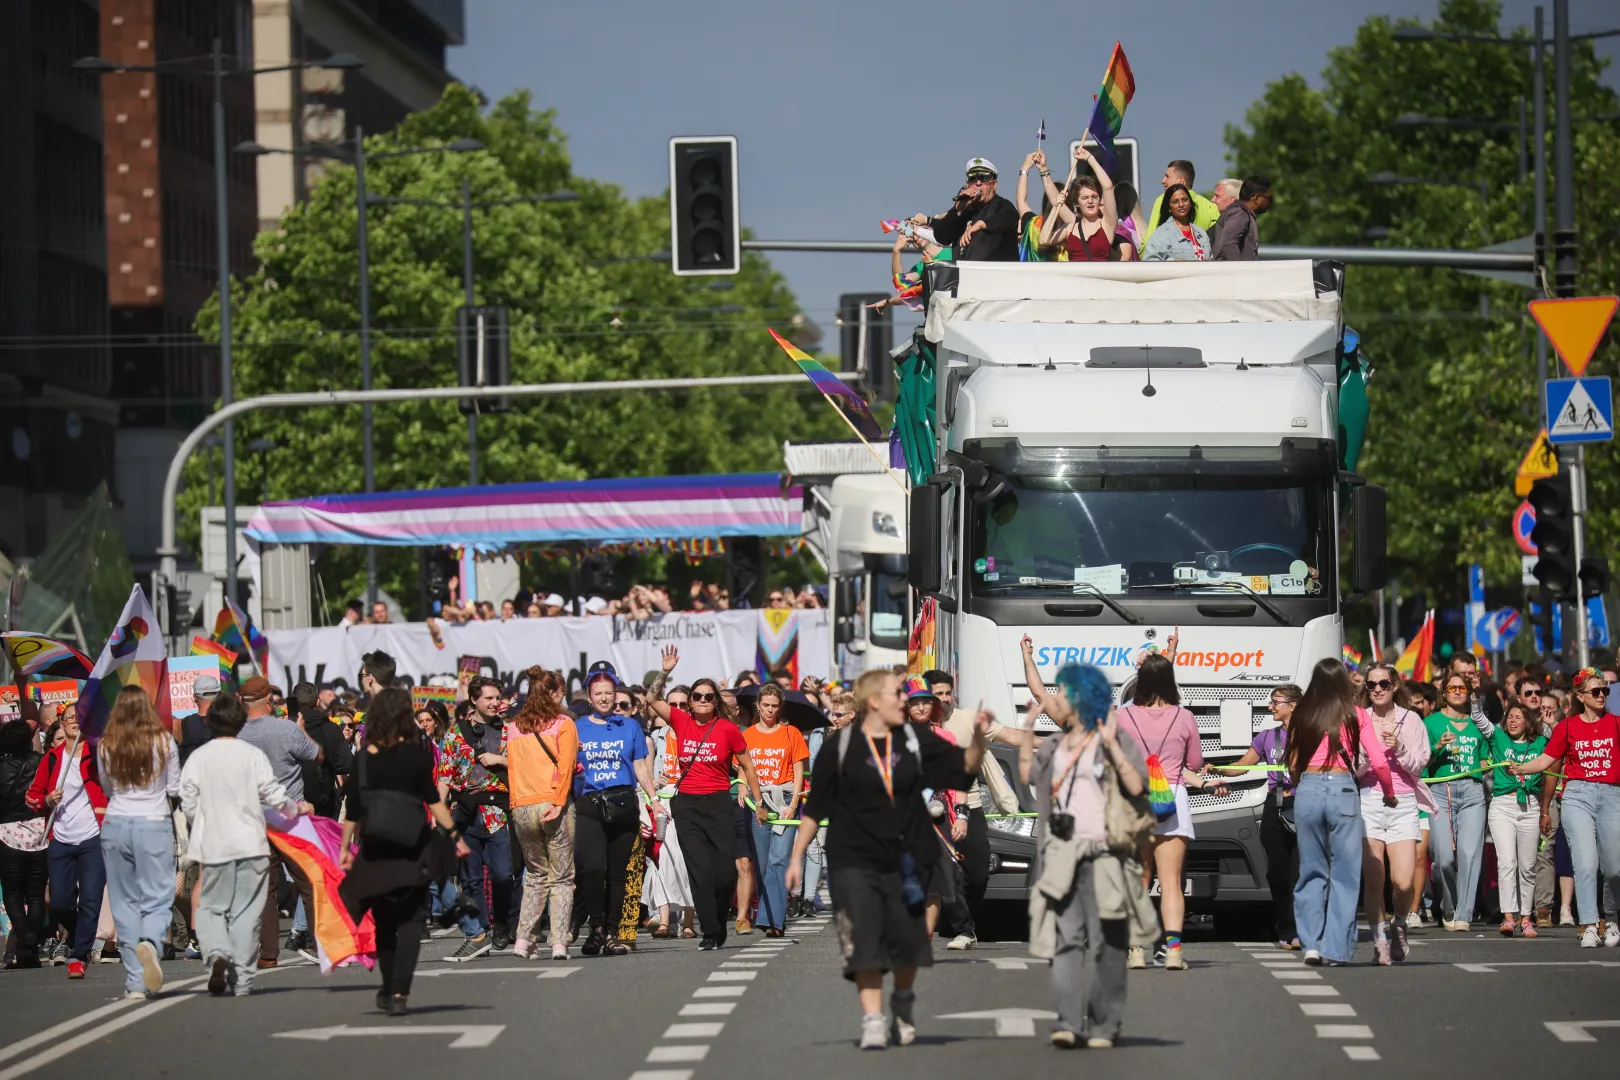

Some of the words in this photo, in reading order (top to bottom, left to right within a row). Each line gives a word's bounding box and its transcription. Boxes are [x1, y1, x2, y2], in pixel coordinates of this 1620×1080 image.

[1037, 646, 1133, 666] STRUZIK
[1160, 649, 1264, 672] tansport
[1229, 672, 1291, 681] ACTROS
[43, 690, 74, 700] WANT
[582, 741, 598, 751] LIFE
[602, 740, 624, 749] ISN'T
[683, 739, 696, 747] LIFE
[1575, 740, 1590, 750] LIFE
[1592, 737, 1613, 747] ISN'T
[586, 750, 622, 760] BINARY,
[764, 748, 785, 758] ISN'T
[1578, 748, 1612, 760] BINARY,
[752, 758, 782, 770] BINARY,
[1467, 755, 1474, 764] IS
[1580, 760, 1600, 769] NOR
[1602, 760, 1611, 769] IS
[589, 760, 610, 770] NOR
[612, 761, 620, 770] IS
[1450, 764, 1470, 773] LOVE
[594, 772, 617, 782] LOVE
[771, 770, 780, 779] IS
[1585, 769, 1607, 778] LOVE
